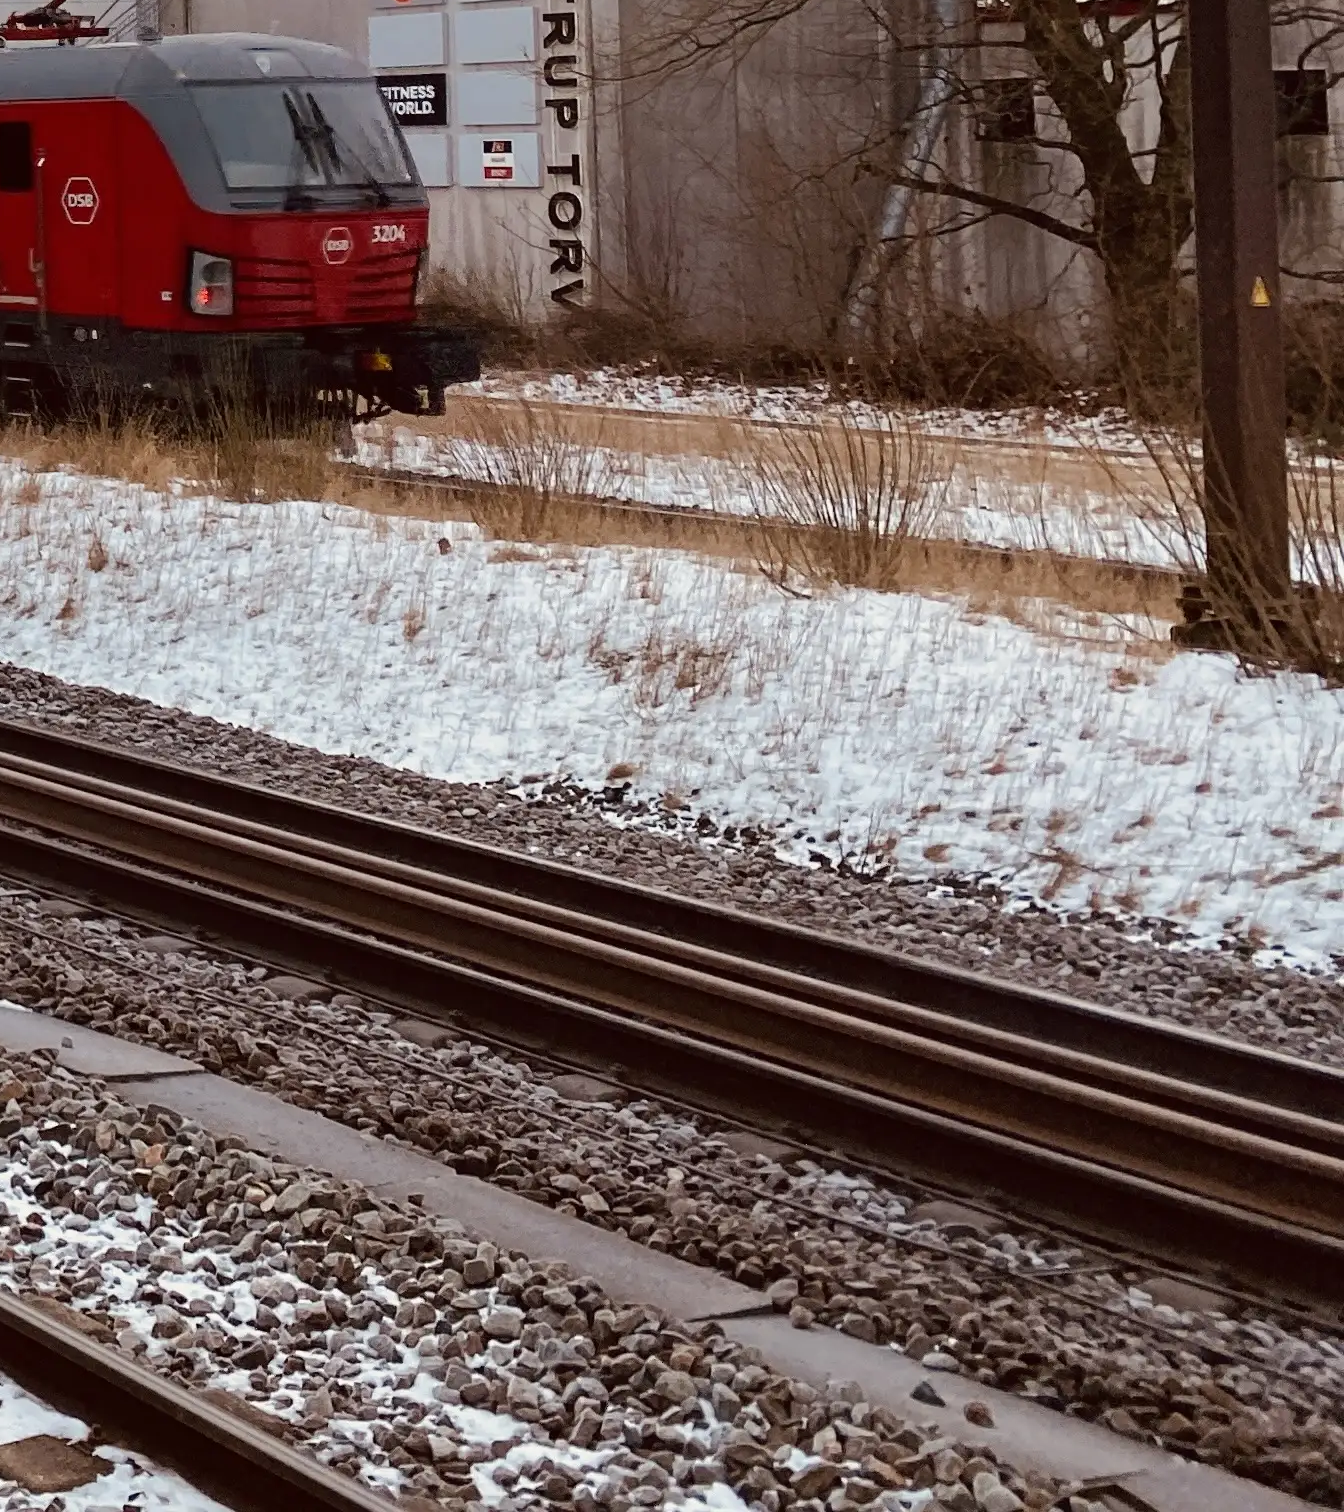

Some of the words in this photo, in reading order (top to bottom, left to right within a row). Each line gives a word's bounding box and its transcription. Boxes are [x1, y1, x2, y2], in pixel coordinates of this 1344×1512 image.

[67, 194, 94, 208] DSB
[371, 225, 406, 243] 3204
[547, 154, 586, 309] TORV
